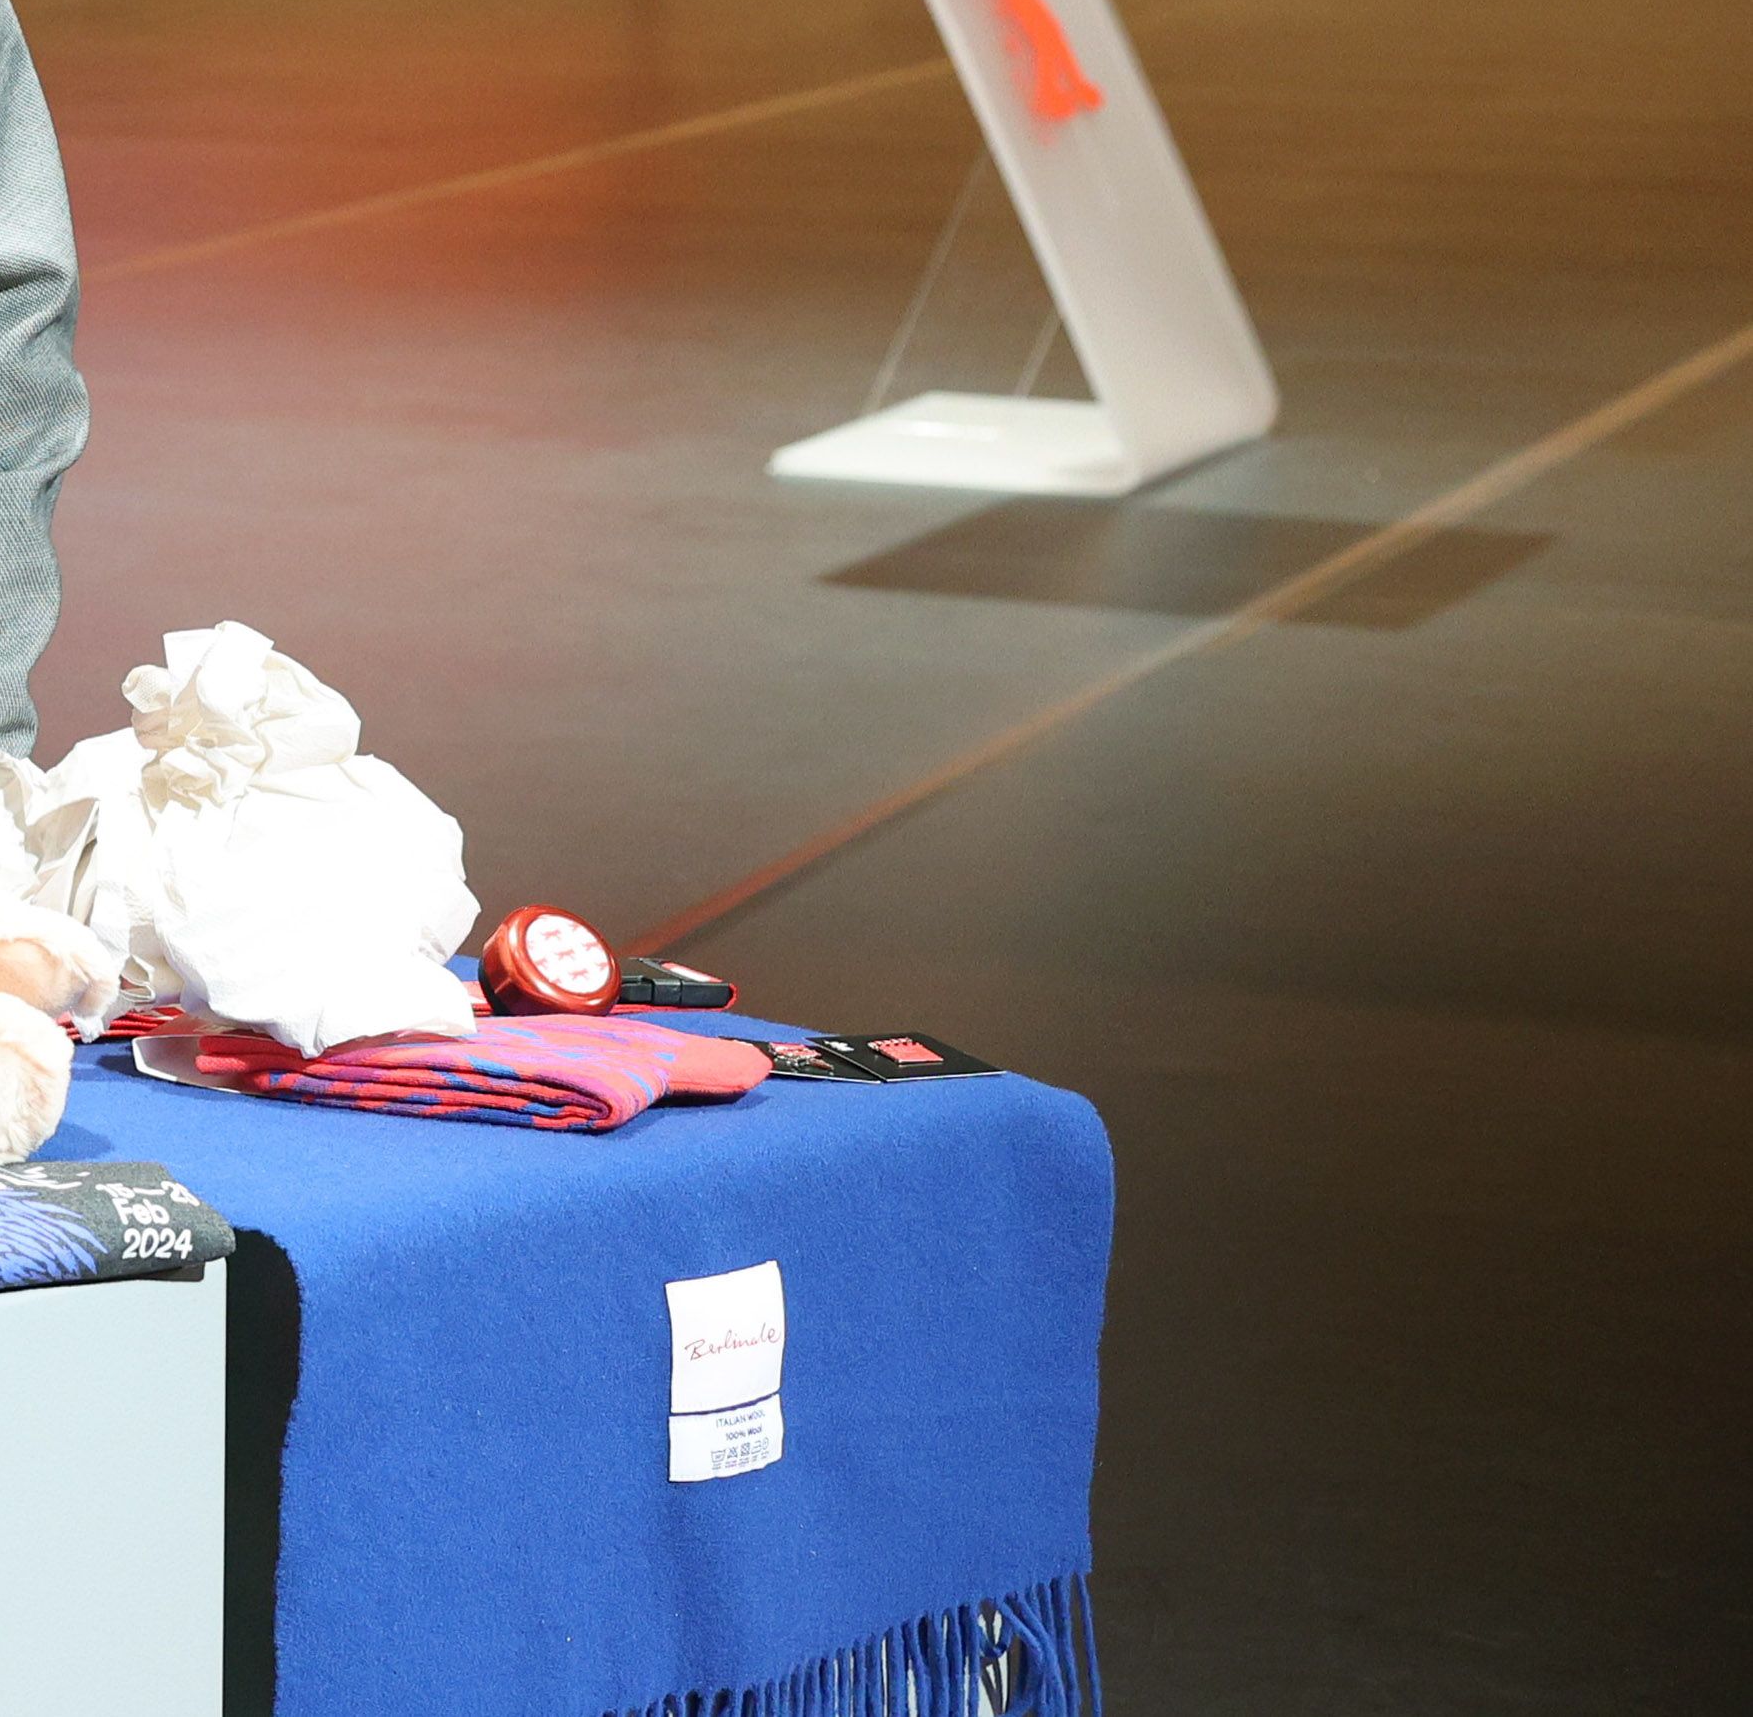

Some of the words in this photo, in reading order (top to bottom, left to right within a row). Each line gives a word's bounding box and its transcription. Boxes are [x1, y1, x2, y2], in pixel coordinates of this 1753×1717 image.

[112, 1197, 171, 1226] Feb
[121, 1227, 194, 1260] 2024
[684, 1322, 781, 1361] Berlinale
